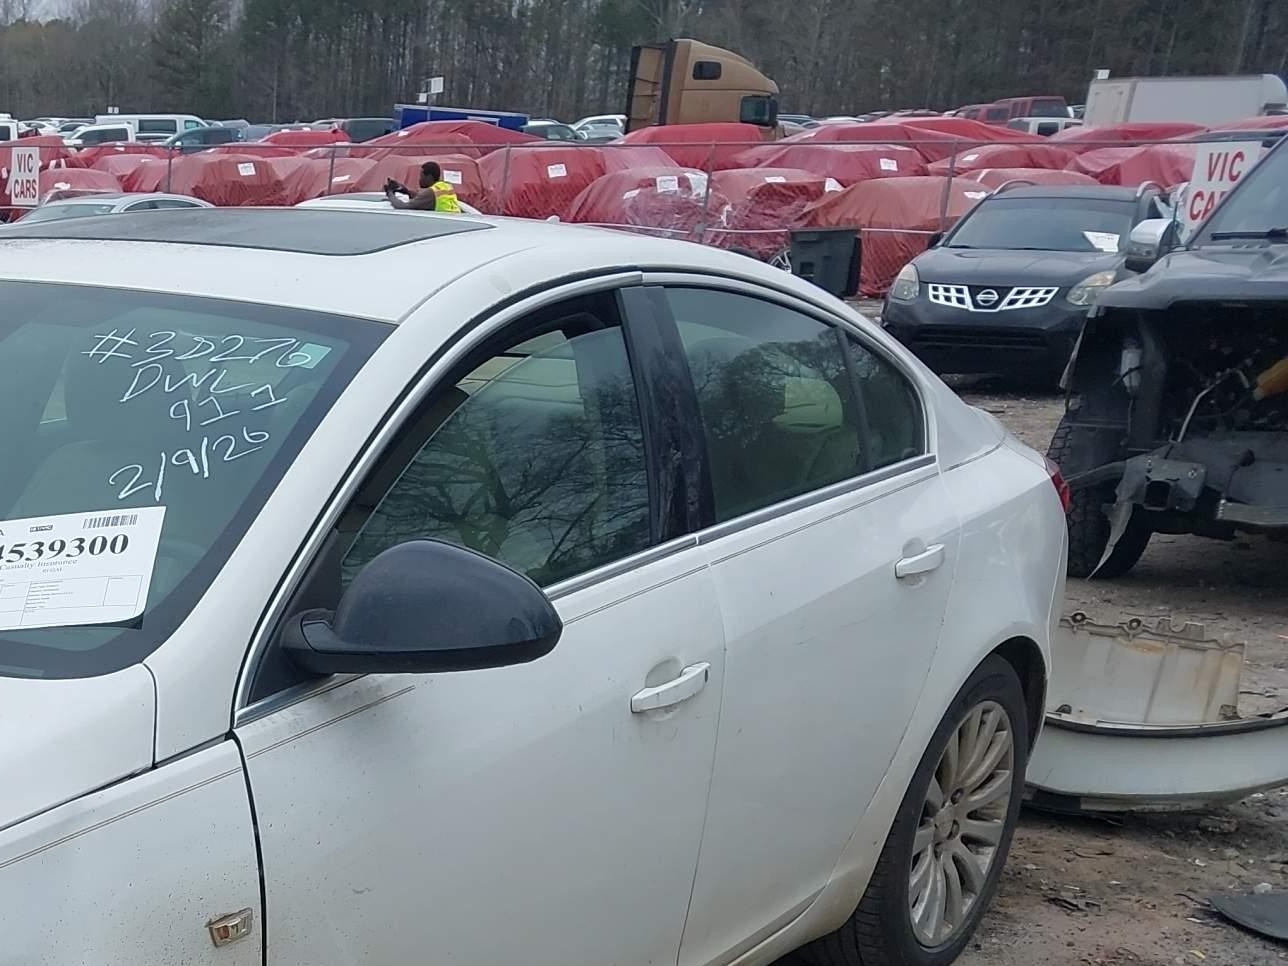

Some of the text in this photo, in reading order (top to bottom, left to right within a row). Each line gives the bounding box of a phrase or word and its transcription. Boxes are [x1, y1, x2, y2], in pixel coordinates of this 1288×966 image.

[16, 153, 34, 173] VIC
[1208, 151, 1245, 182] VIC
[13, 179, 37, 199] CARS
[108, 426, 270, 501] 2/9/26
[0, 562, 34, 571] Casualty
[37, 559, 78, 568] Insurance
